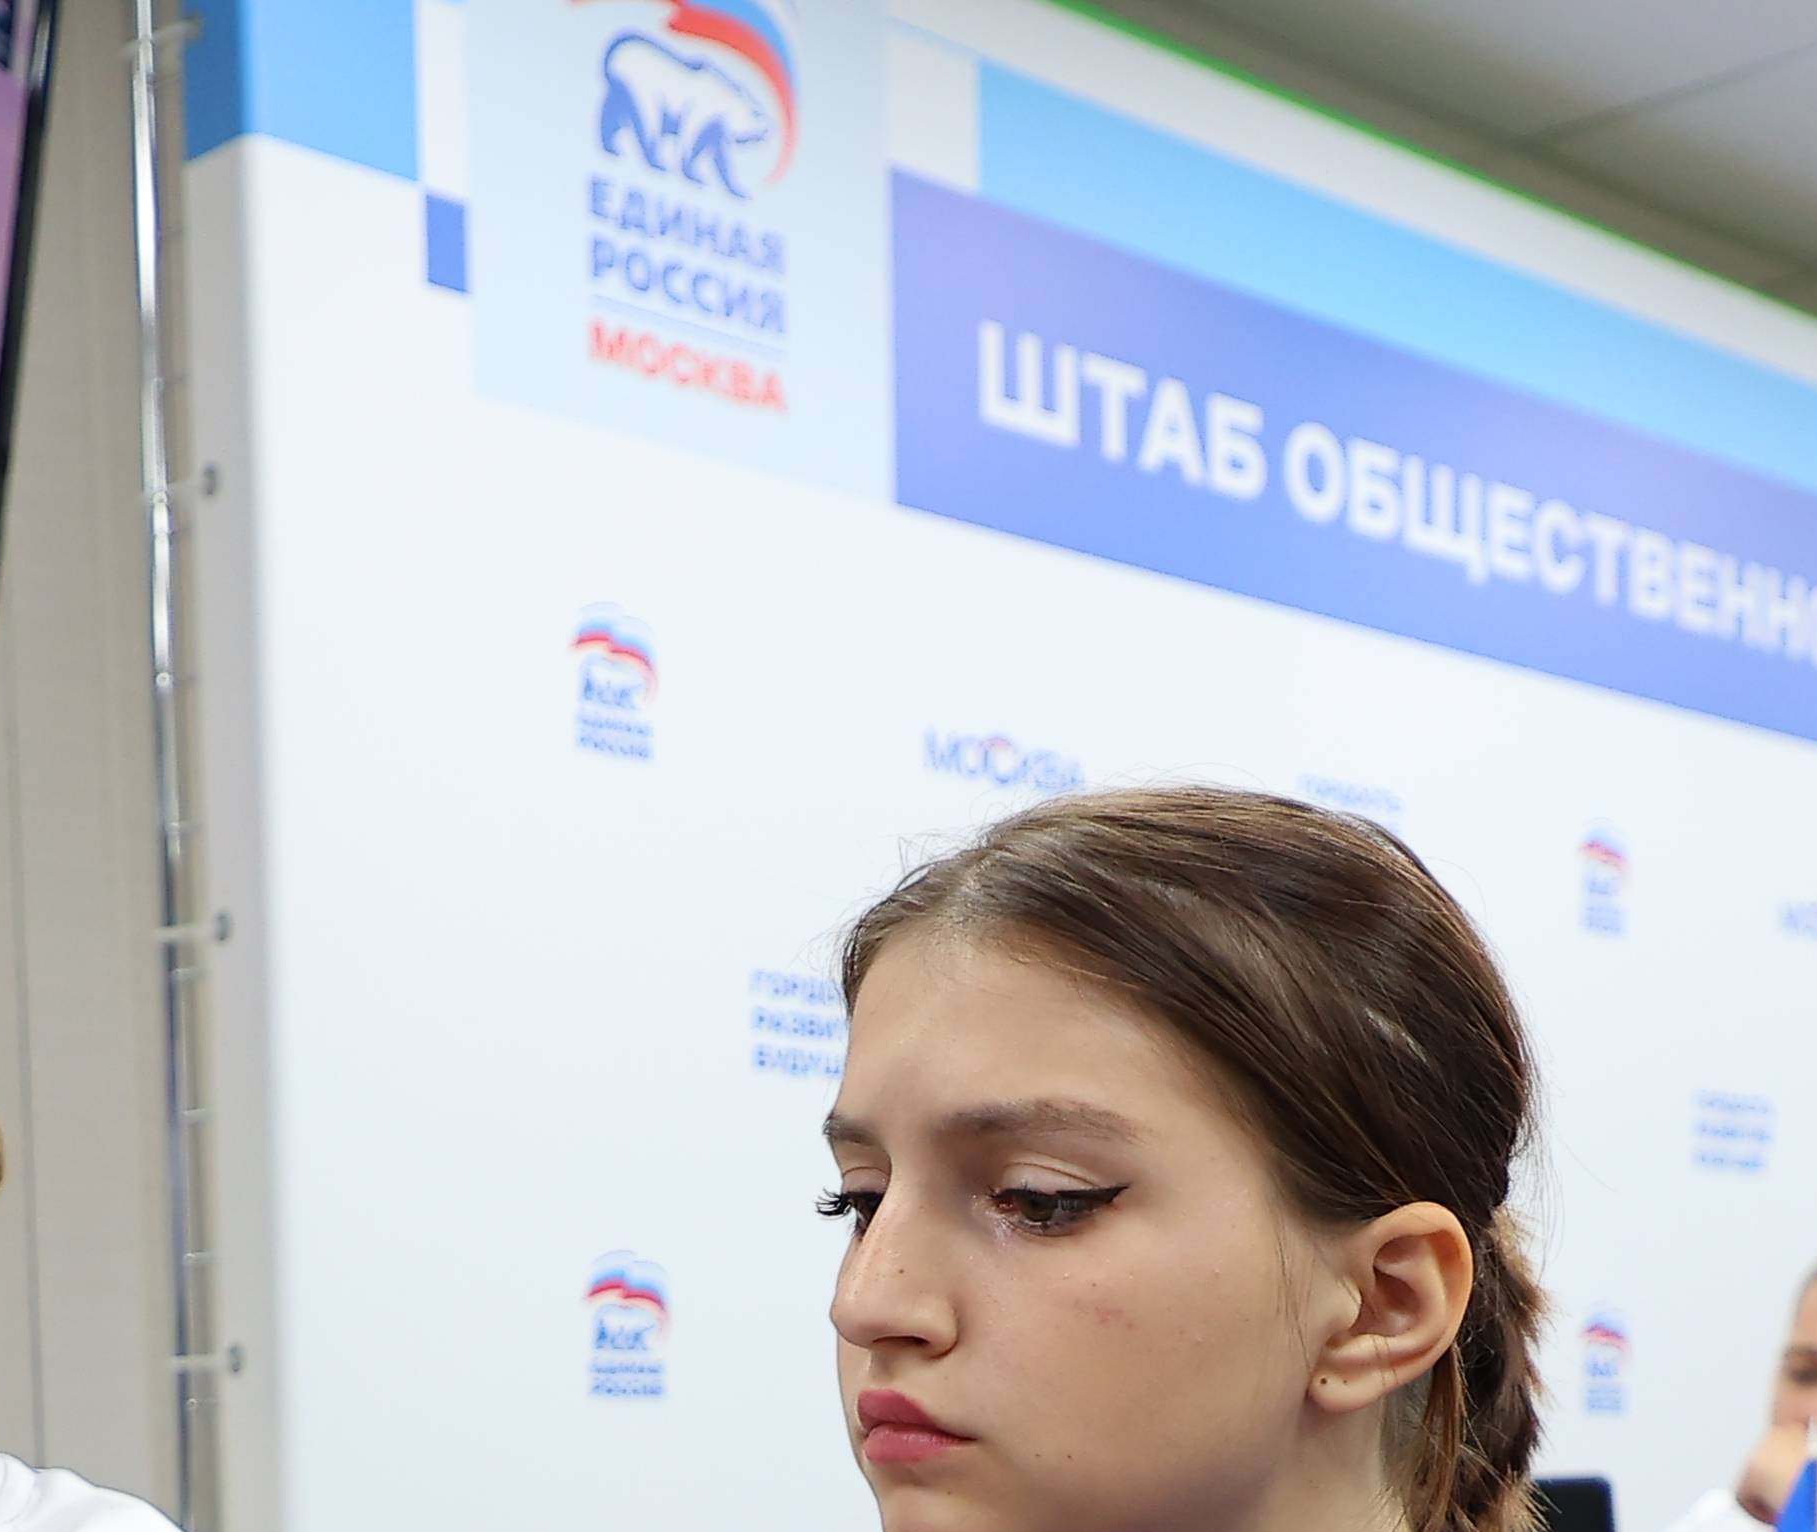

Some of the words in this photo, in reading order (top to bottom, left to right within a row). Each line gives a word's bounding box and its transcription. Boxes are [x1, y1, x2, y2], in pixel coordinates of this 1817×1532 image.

[590, 177, 785, 275] ЕДИНАЯ
[591, 236, 785, 333] РОССИЯ
[589, 319, 789, 412] МОСКВА
[979, 317, 1270, 501] ШТАБ
